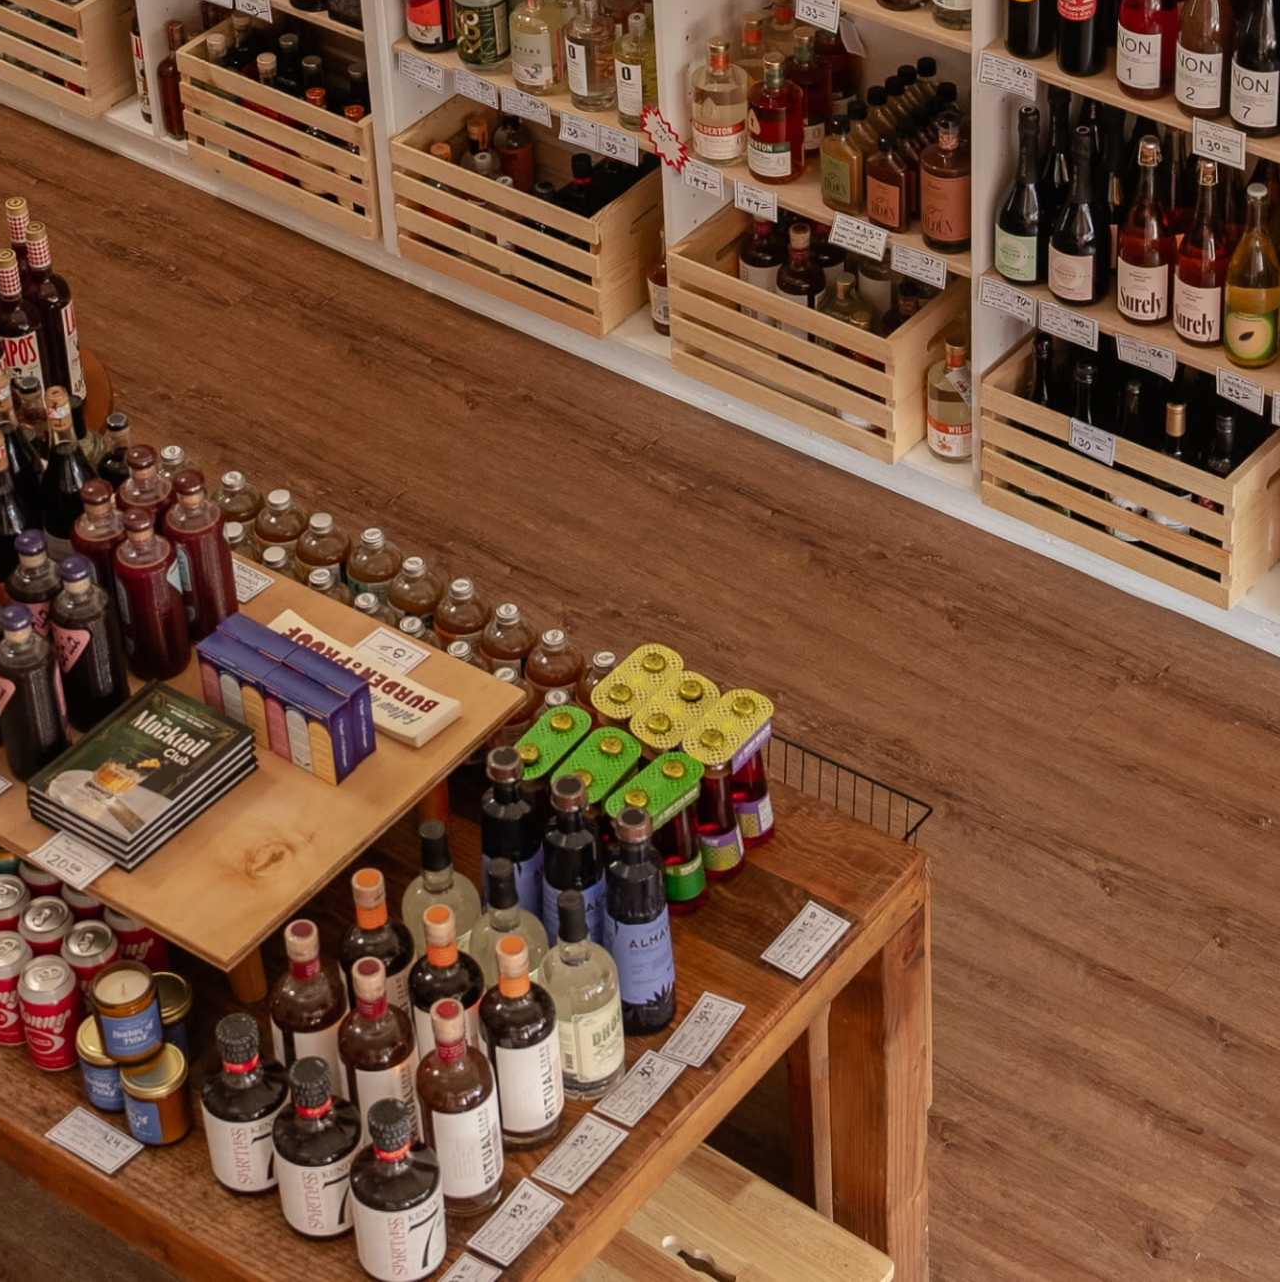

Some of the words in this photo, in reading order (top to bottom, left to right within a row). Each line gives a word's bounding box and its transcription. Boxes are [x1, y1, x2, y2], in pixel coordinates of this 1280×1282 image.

[1119, 36, 1152, 56] NON
[1126, 67, 1133, 80] 1
[1178, 54, 1213, 74] NON
[1233, 72, 1269, 94] NON
[1184, 86, 1195, 101] 2
[1242, 106, 1251, 119] 7
[1119, 286, 1162, 314] Surely
[130, 709, 211, 758] Mocktail
[163, 748, 189, 766] Club
